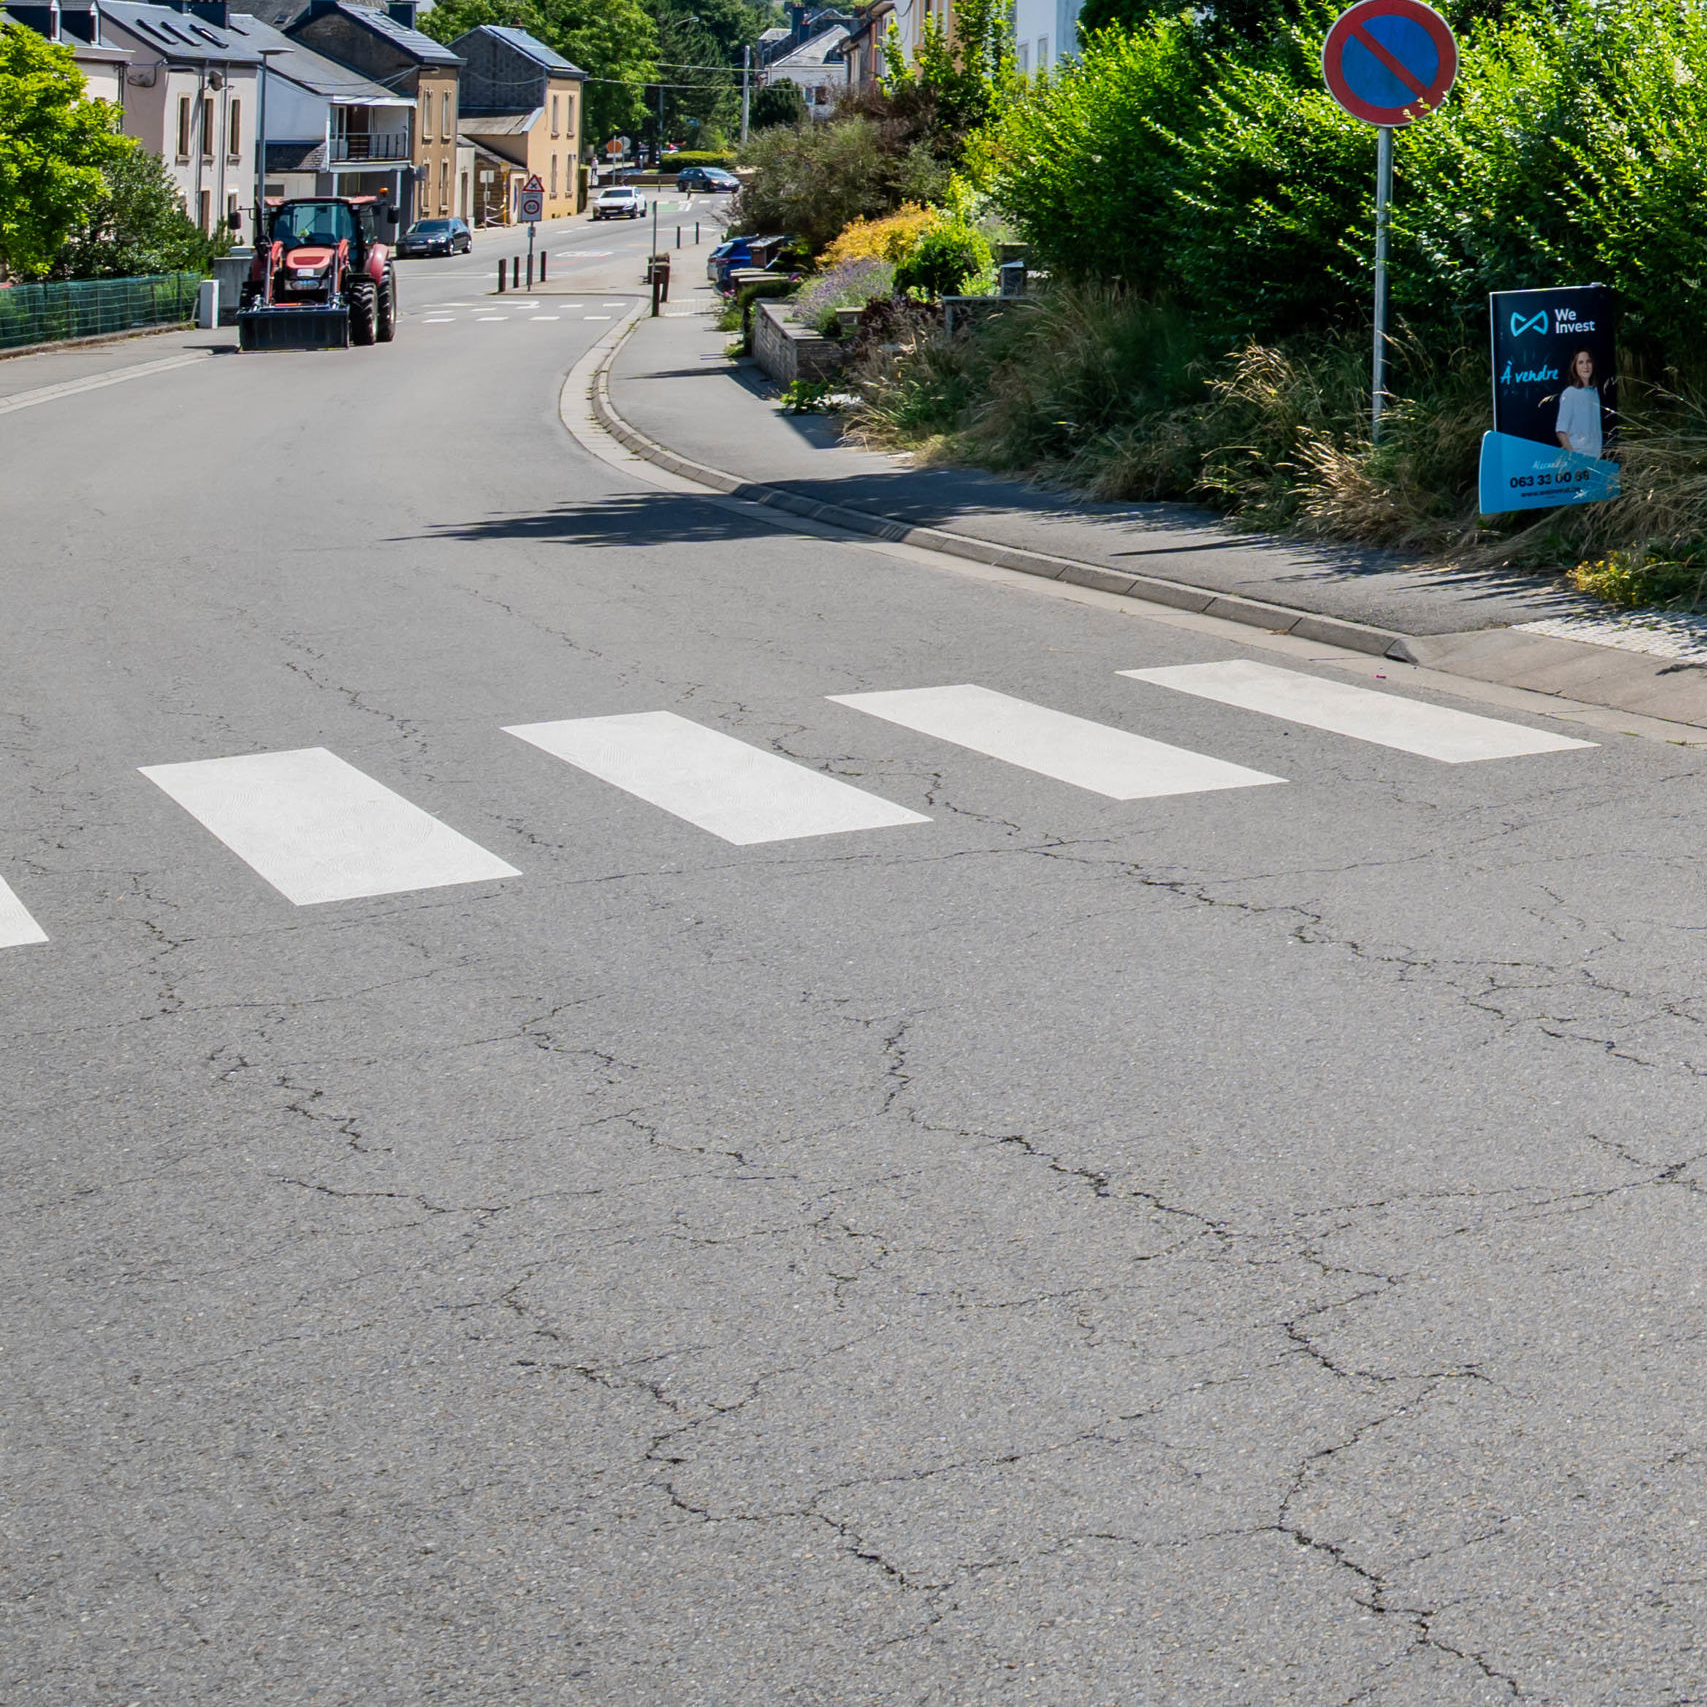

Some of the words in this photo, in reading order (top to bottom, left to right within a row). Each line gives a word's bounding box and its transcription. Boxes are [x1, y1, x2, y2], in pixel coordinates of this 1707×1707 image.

[1554, 308, 1577, 321] We
[1555, 320, 1596, 334] Invest
[1500, 360, 1513, 385] À
[1515, 364, 1559, 383] vendre
[1510, 476, 1534, 488] 063
